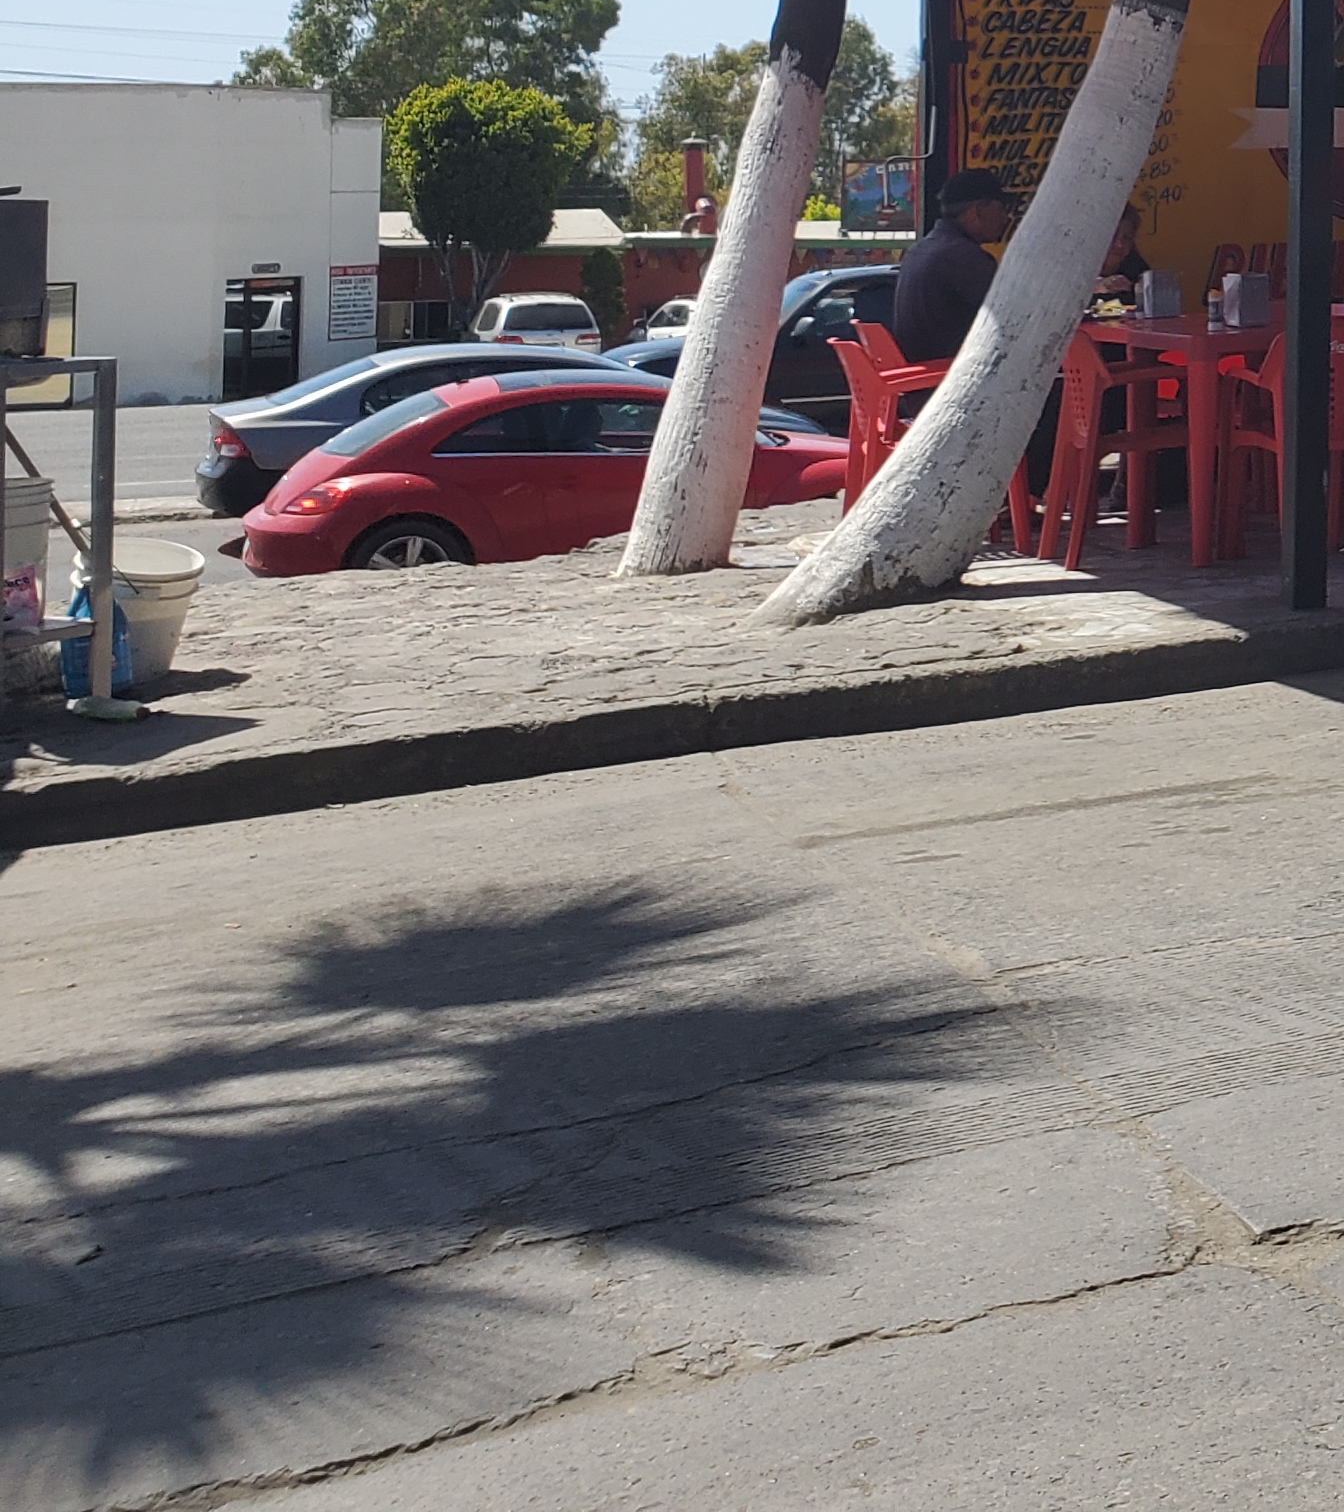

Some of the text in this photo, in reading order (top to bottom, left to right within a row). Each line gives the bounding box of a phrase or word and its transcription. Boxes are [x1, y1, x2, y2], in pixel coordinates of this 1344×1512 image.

[981, 9, 1087, 34] CABEZA
[979, 35, 1093, 60] LENGUA
[987, 61, 1089, 86] MIXTO
[981, 87, 1076, 115] FANTAS
[981, 112, 1067, 139] MULIT
